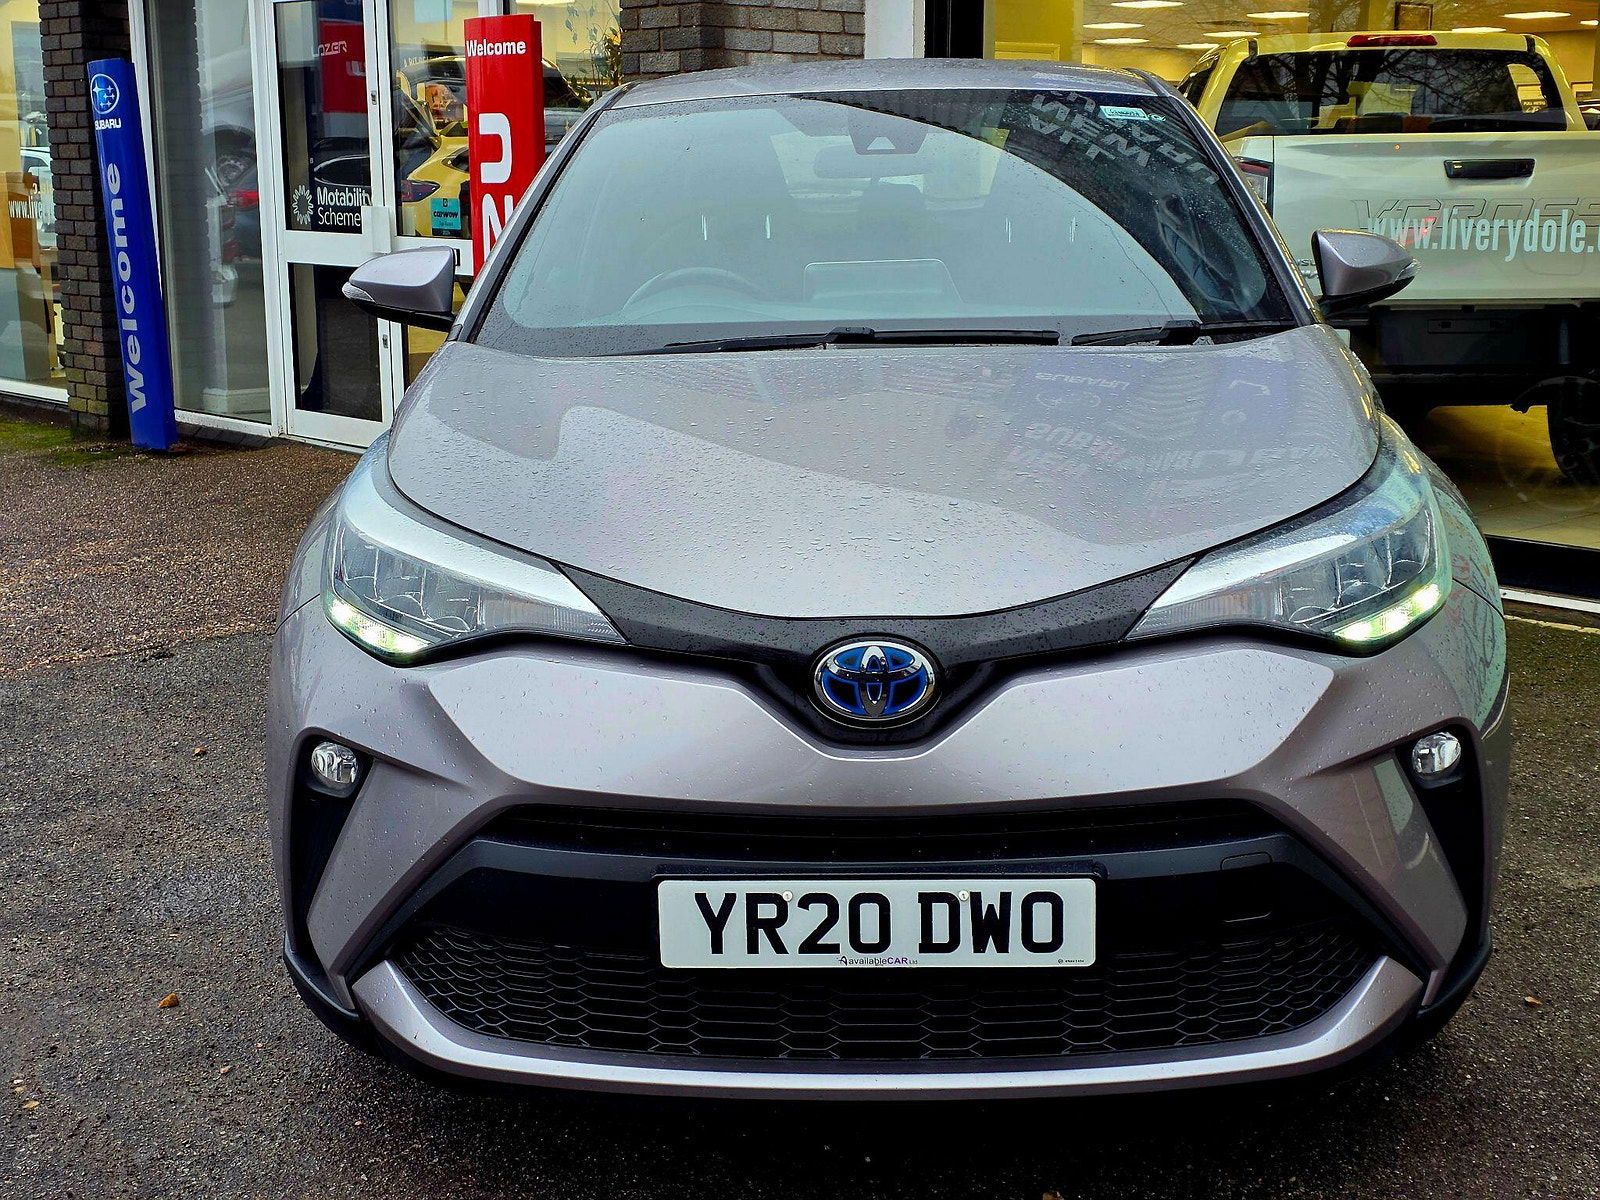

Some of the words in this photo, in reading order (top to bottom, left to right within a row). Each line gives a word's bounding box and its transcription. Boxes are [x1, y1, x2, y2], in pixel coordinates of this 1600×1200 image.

[466, 39, 527, 57] Welcome
[94, 117, 122, 131] SUBARU
[317, 207, 362, 227] Scheme
[433, 211, 459, 219] carwow
[107, 162, 146, 413] welcome
[694, 891, 891, 955] YR20
[918, 891, 1064, 954] DWO
